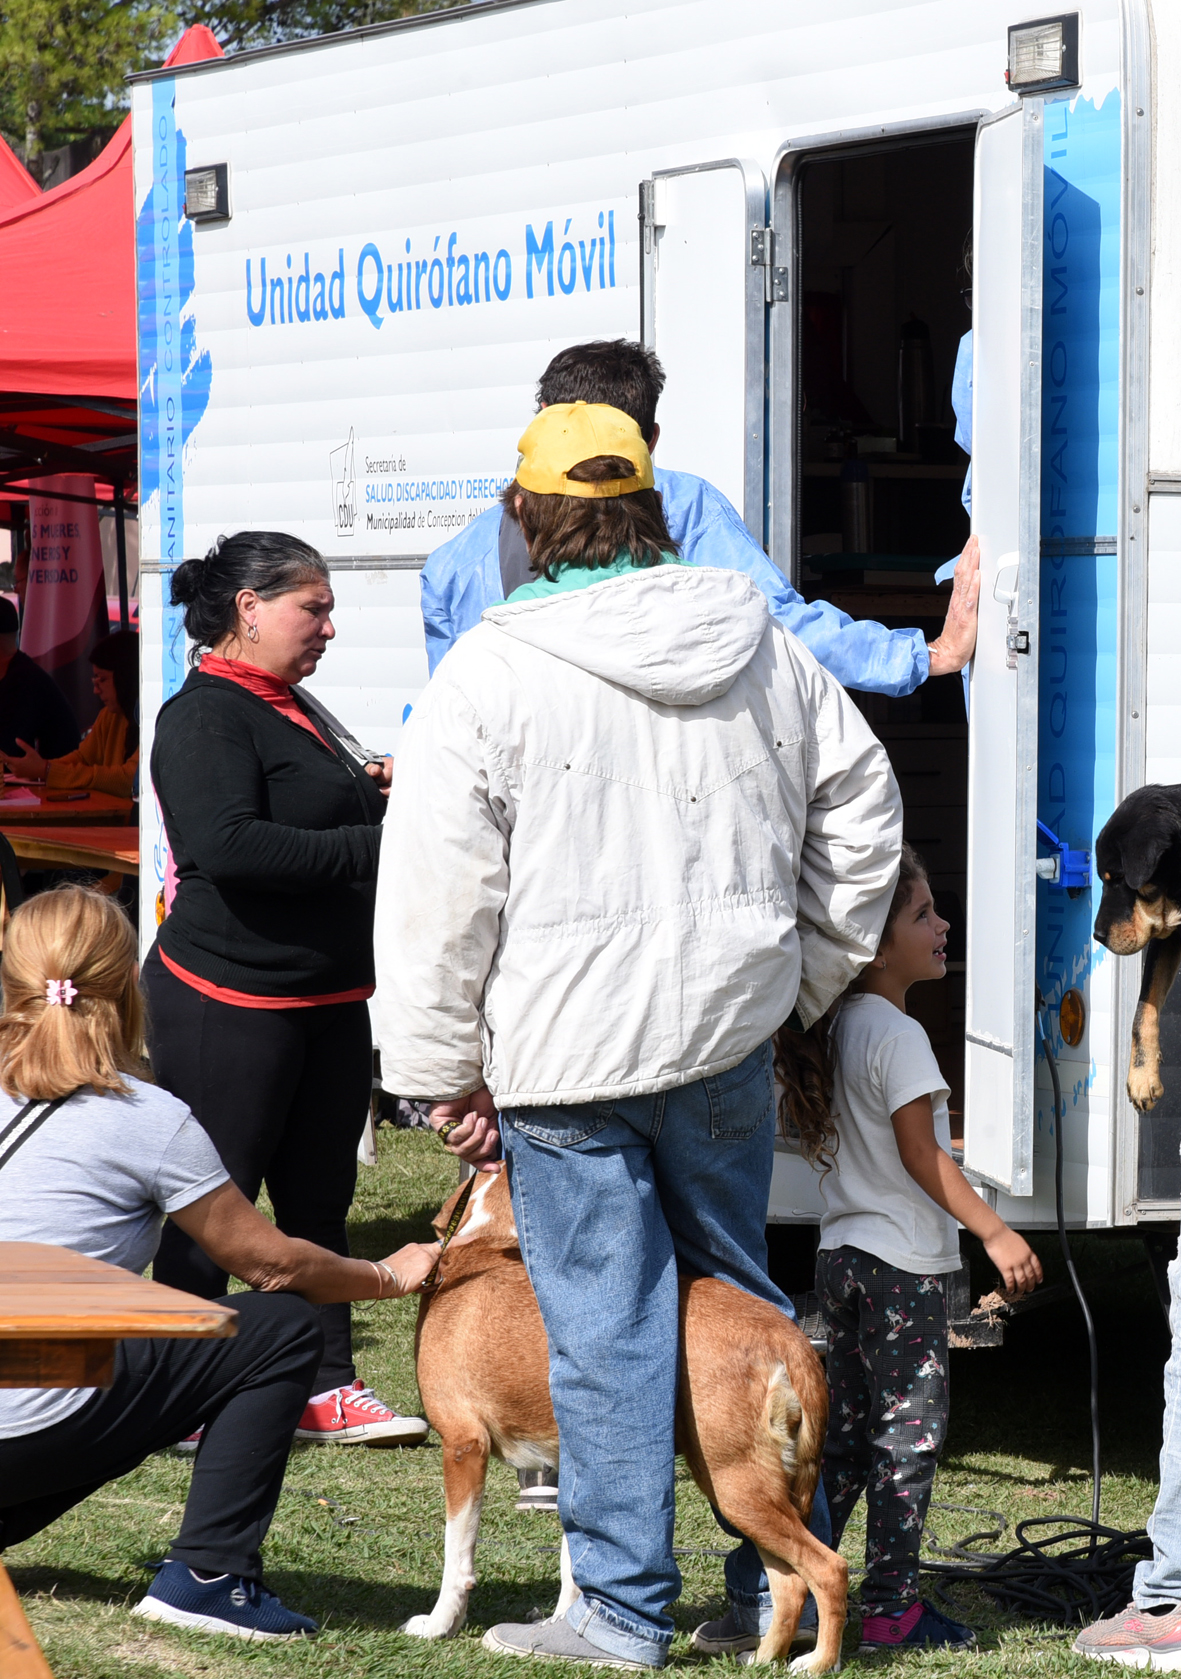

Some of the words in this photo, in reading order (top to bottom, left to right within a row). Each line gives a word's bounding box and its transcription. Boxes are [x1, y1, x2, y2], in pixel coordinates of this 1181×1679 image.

[158, 115, 173, 372] CONTROLADO
[245, 247, 347, 328] Unidad
[356, 231, 512, 330] Quirófano
[525, 209, 616, 299] Móvil
[1047, 106, 1069, 316] MÓVIL
[166, 396, 176, 589] ANITARIO
[338, 503, 354, 528] CDU
[365, 454, 397, 473] Secretaría
[398, 454, 407, 472] de
[365, 483, 395, 506] SALUD,
[366, 510, 415, 535] Municipalidad
[417, 509, 425, 529] de
[1045, 762, 1067, 1010] UNIAD
